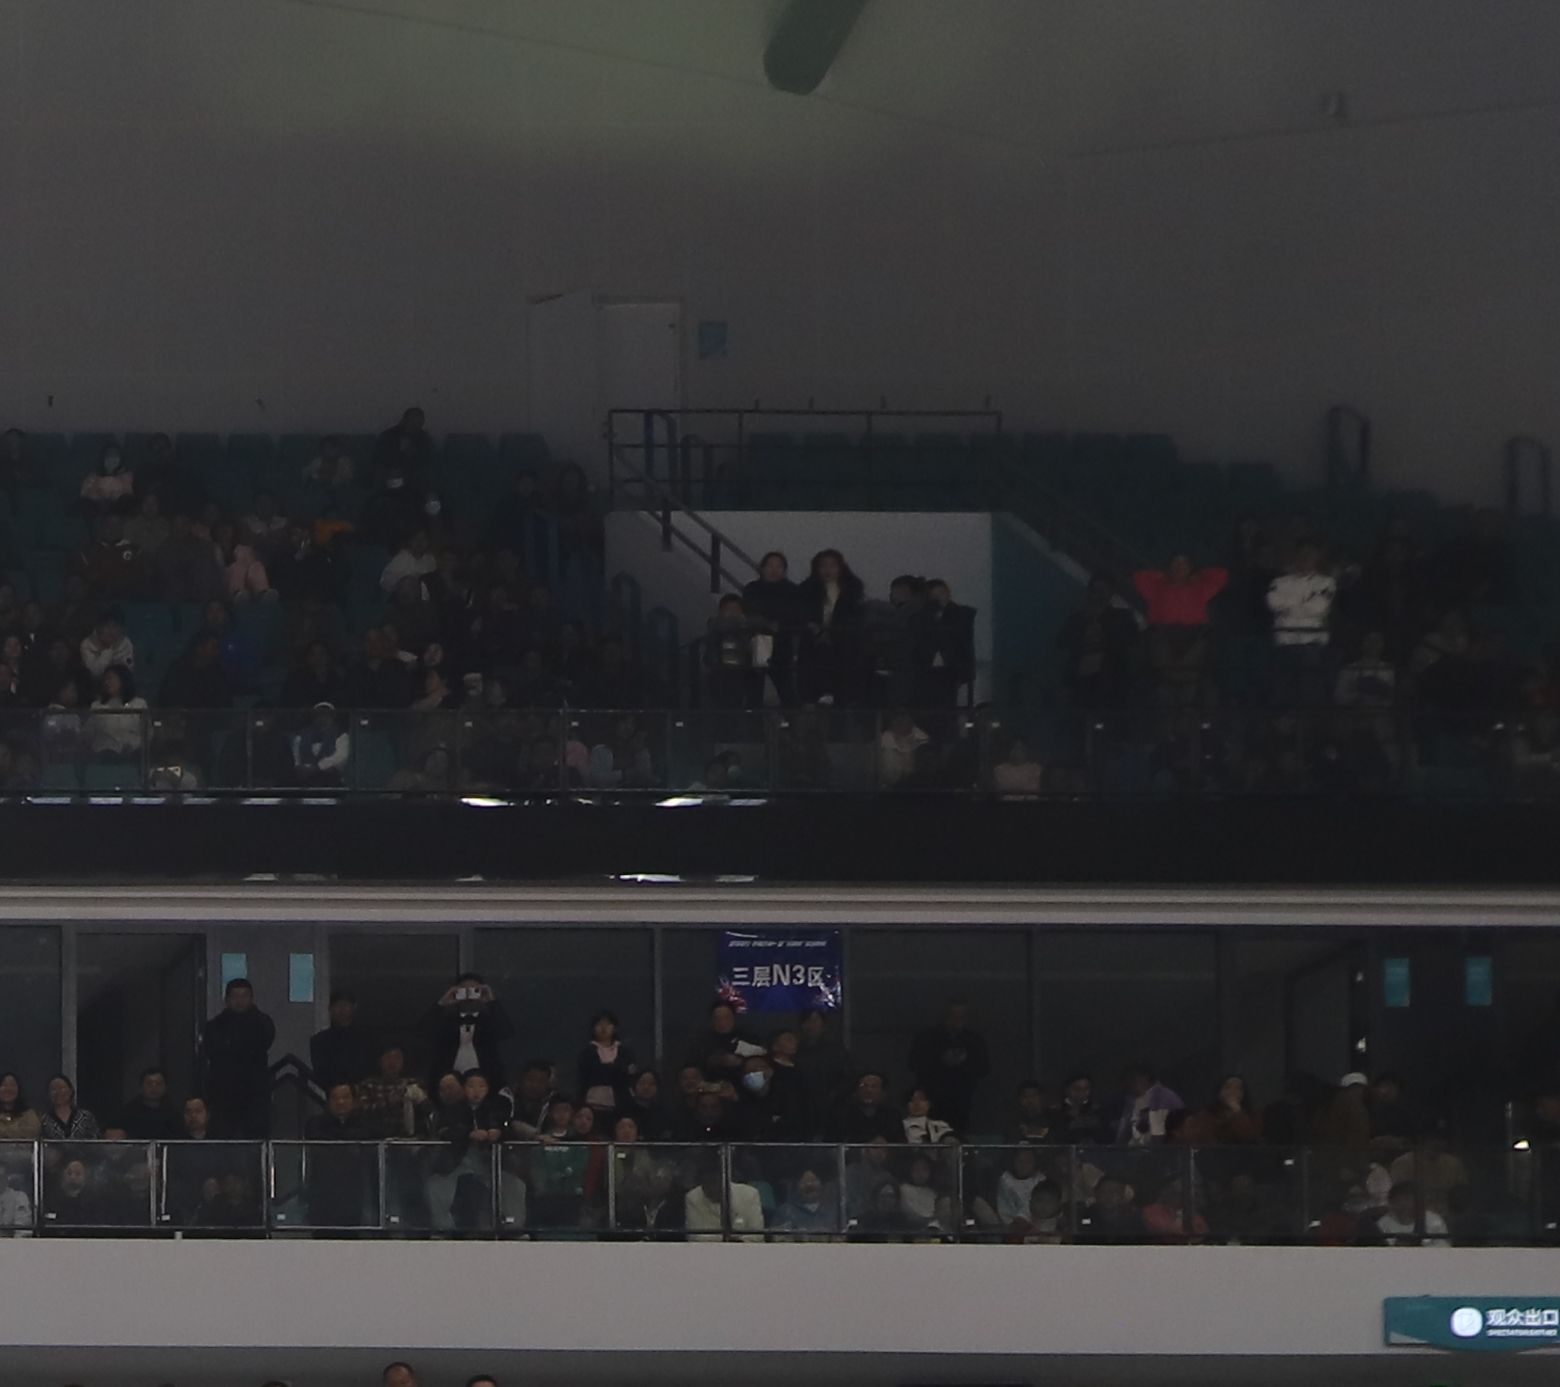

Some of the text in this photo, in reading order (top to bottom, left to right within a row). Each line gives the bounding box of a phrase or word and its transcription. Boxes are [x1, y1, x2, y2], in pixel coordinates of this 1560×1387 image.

[732, 964, 826, 988] 三层N3区
[1486, 1309, 1559, 1326] 观众出口
